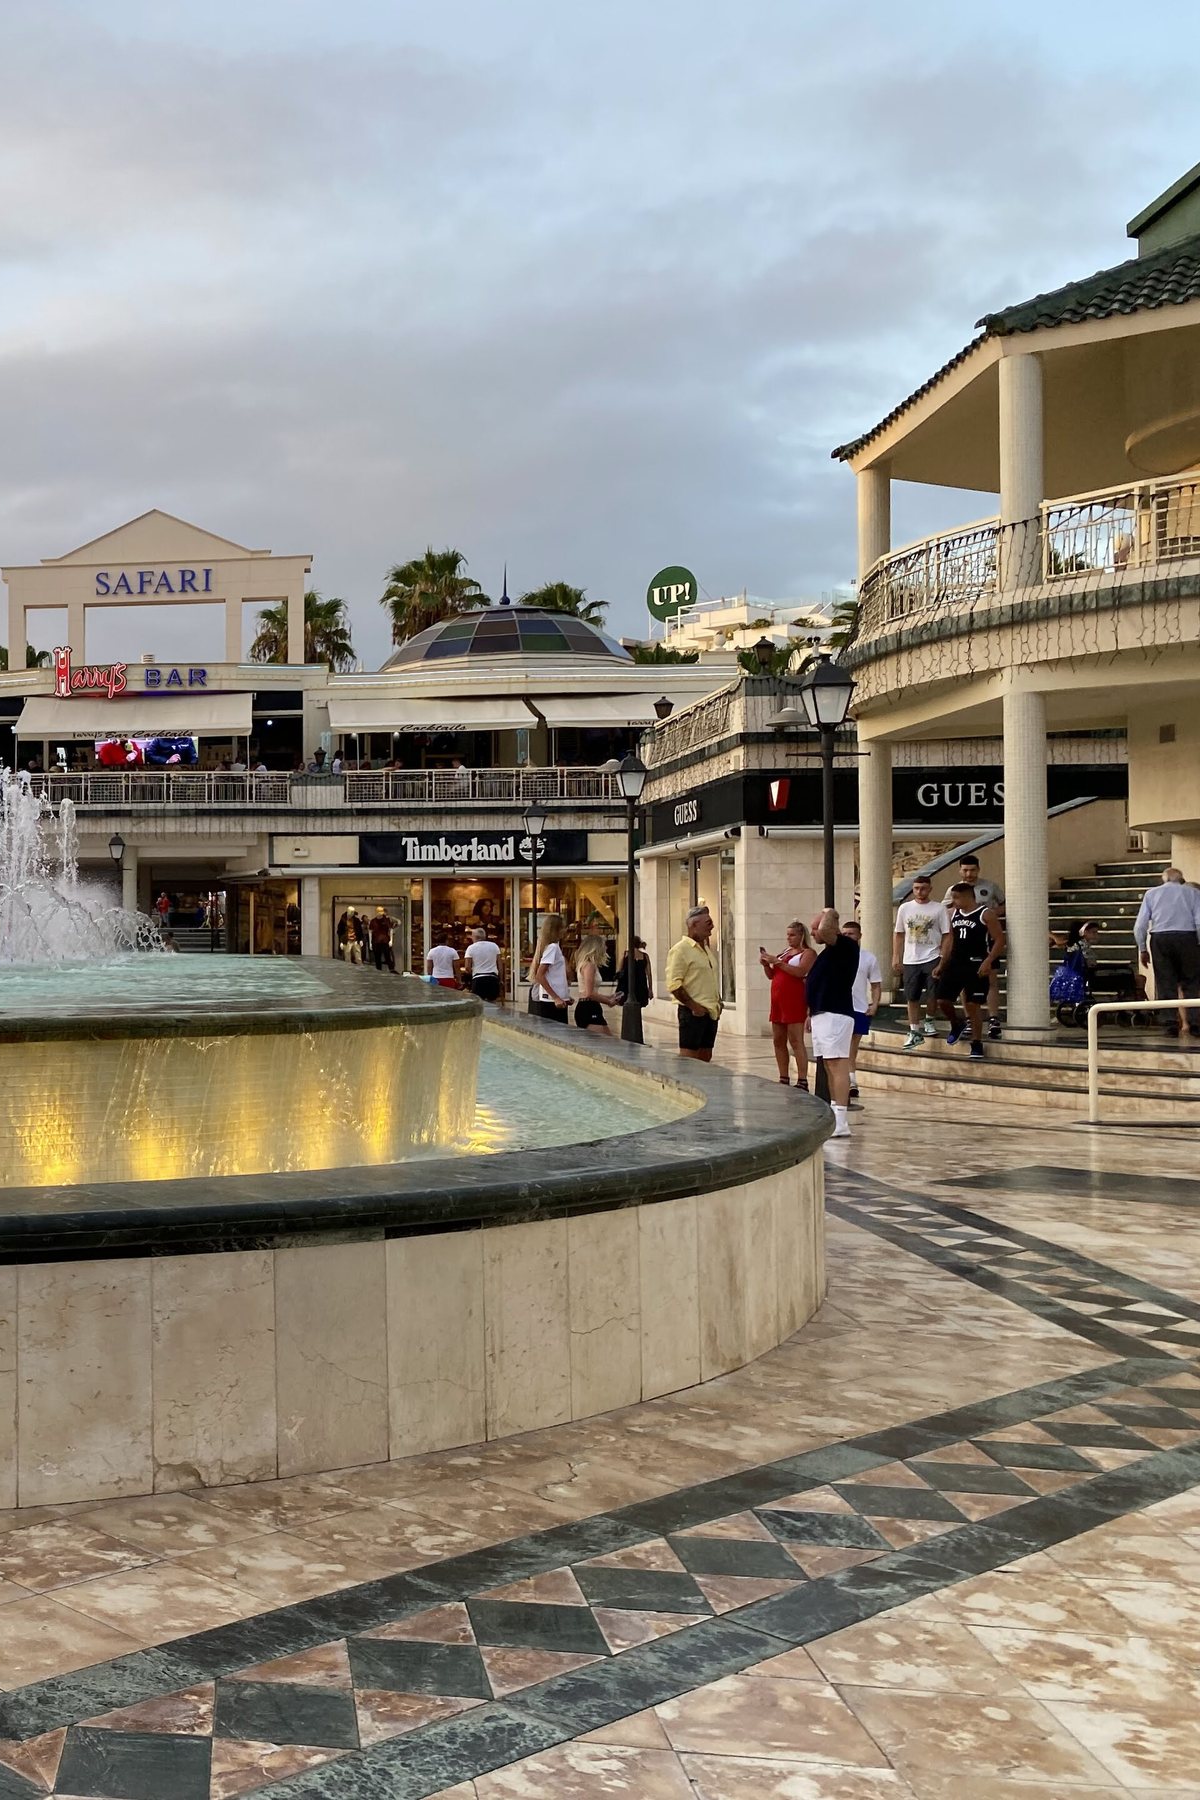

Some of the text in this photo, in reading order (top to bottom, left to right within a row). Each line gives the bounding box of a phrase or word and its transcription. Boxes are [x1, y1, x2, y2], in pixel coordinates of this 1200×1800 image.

[95, 568, 212, 595] SAFARI
[652, 582, 690, 606] UP!
[52, 646, 208, 699] Harry's BAR
[104, 731, 128, 739] Bar
[132, 729, 194, 739] Cocktails
[400, 723, 467, 732] Cocktails
[917, 782, 1004, 807] GUES
[674, 800, 698, 826] GUESS
[401, 836, 515, 861] Timberland
[959, 927, 967, 939] 11
